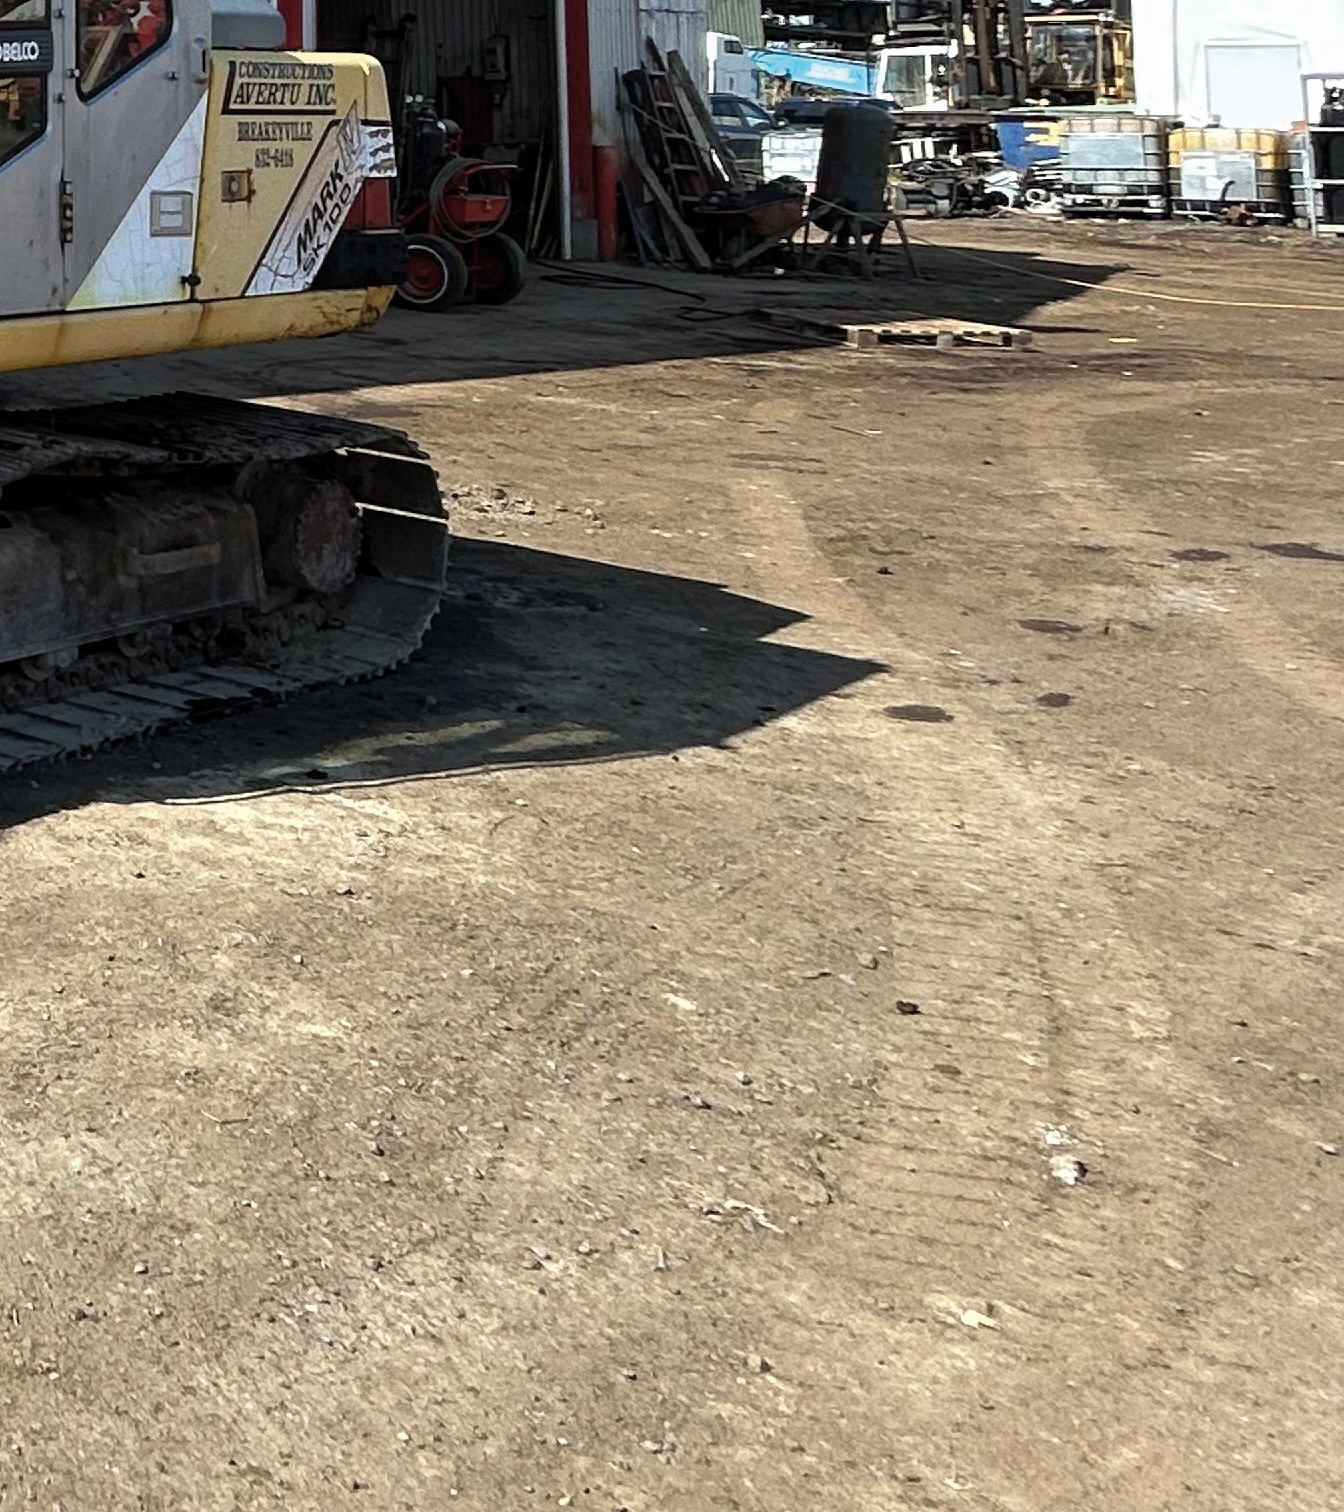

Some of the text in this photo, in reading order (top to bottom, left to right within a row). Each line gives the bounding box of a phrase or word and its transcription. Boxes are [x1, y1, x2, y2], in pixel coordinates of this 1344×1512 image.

[238, 61, 334, 80] CONSTRUCTIONS
[306, 83, 337, 106] INC.
[296, 159, 344, 269] MARK
